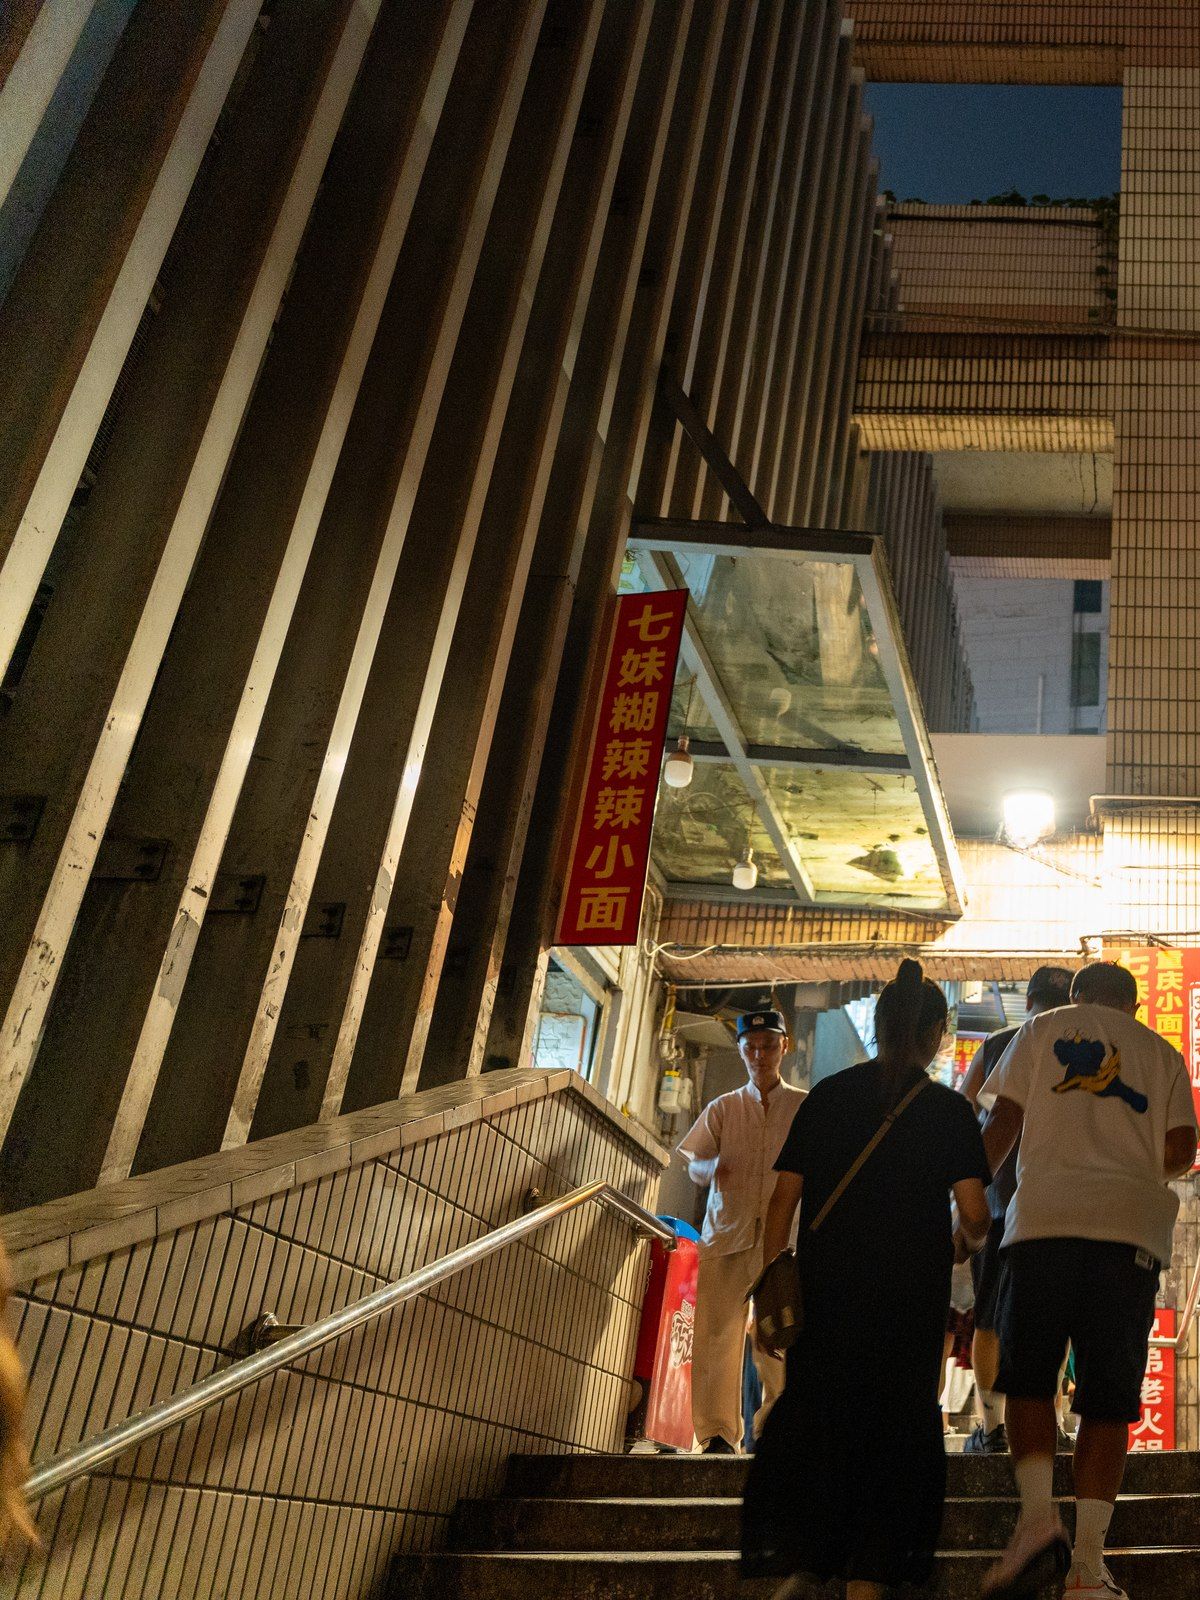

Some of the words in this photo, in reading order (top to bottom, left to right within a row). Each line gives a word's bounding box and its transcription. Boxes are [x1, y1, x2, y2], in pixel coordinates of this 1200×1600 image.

[575, 603, 674, 933] 七妹糊辣辣小面
